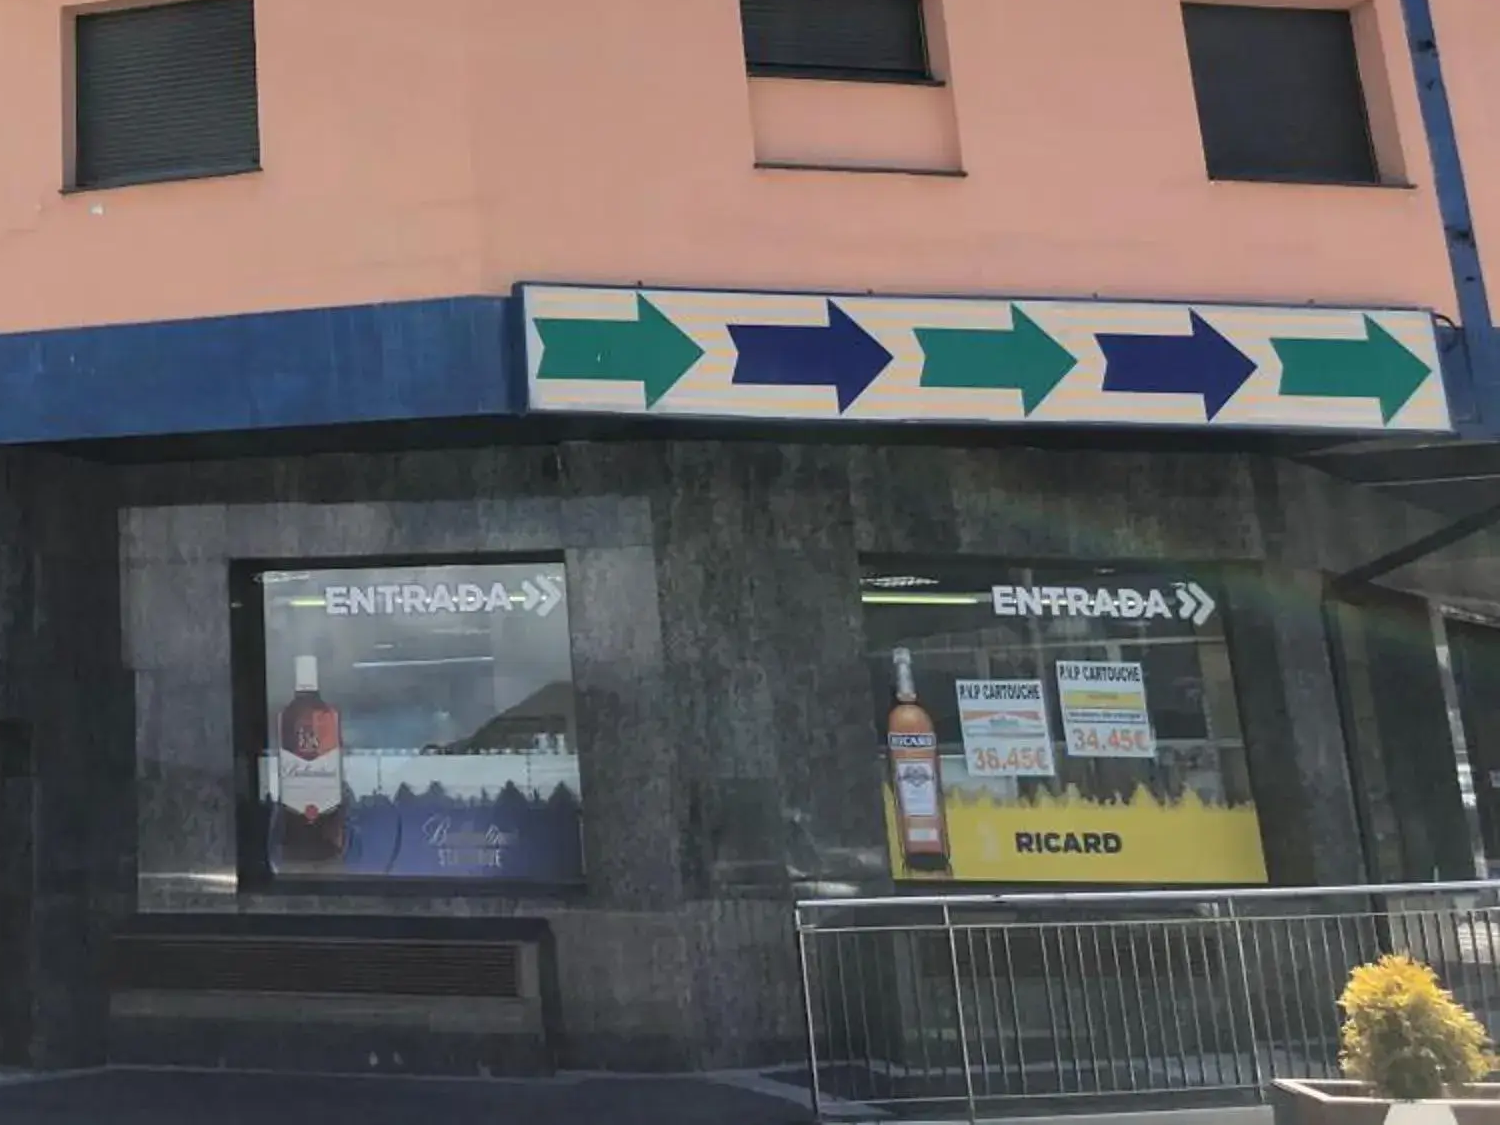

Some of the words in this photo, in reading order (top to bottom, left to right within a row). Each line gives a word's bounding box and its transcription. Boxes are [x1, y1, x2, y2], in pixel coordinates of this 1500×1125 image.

[325, 583, 512, 614] ENTRADA
[992, 586, 1171, 618] ENTRADA
[1084, 666, 1141, 682] CARTOUCHE
[982, 684, 1041, 700] CARTOUCHE
[1015, 832, 1122, 853] RICARD
